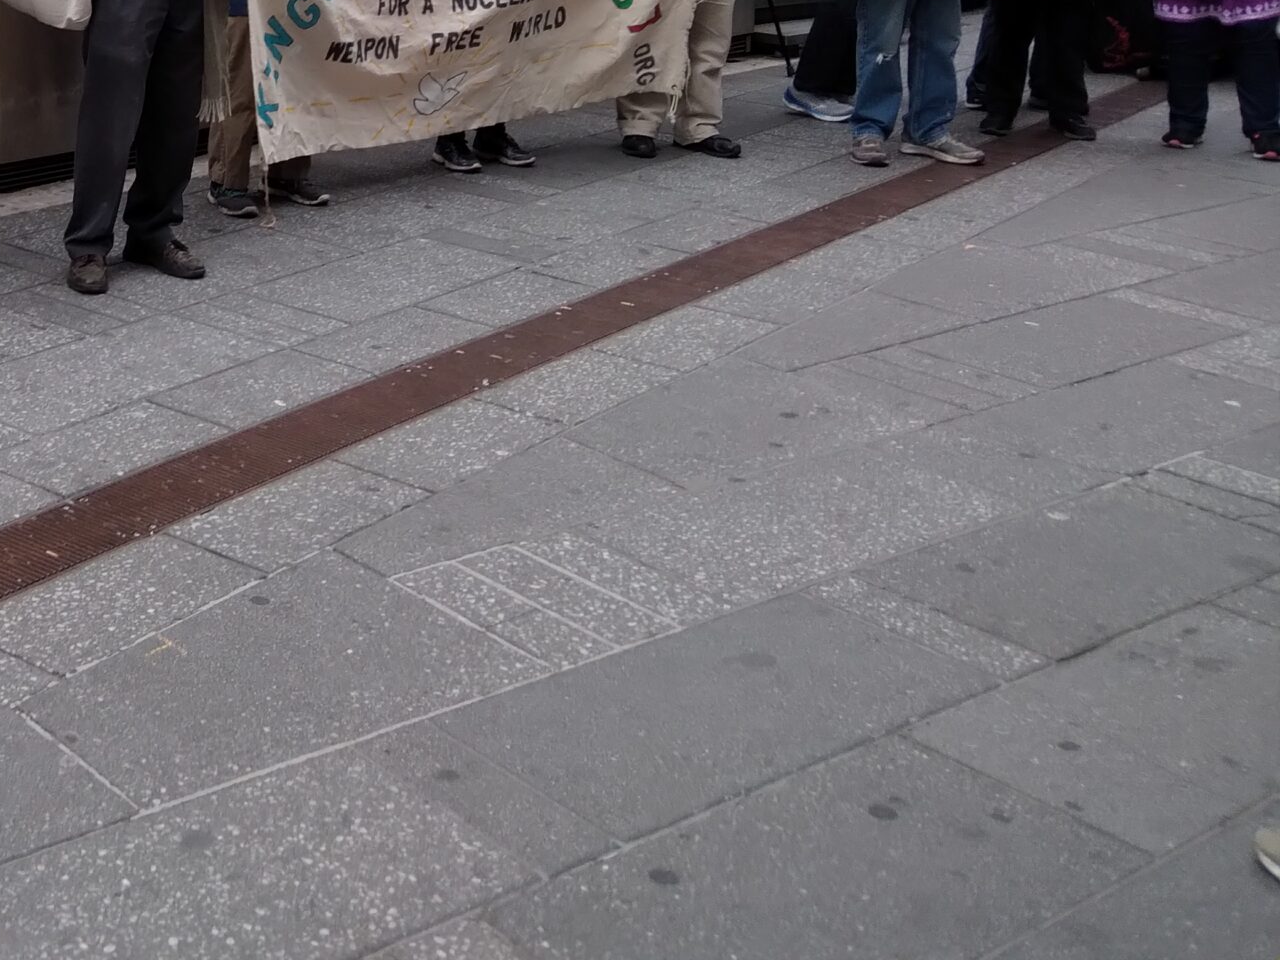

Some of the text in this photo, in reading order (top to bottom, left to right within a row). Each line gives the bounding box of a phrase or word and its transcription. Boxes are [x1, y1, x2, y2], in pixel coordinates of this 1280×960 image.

[324, 34, 400, 64] WEAPON
[429, 25, 482, 56] FREE
[632, 42, 657, 87] ORG
